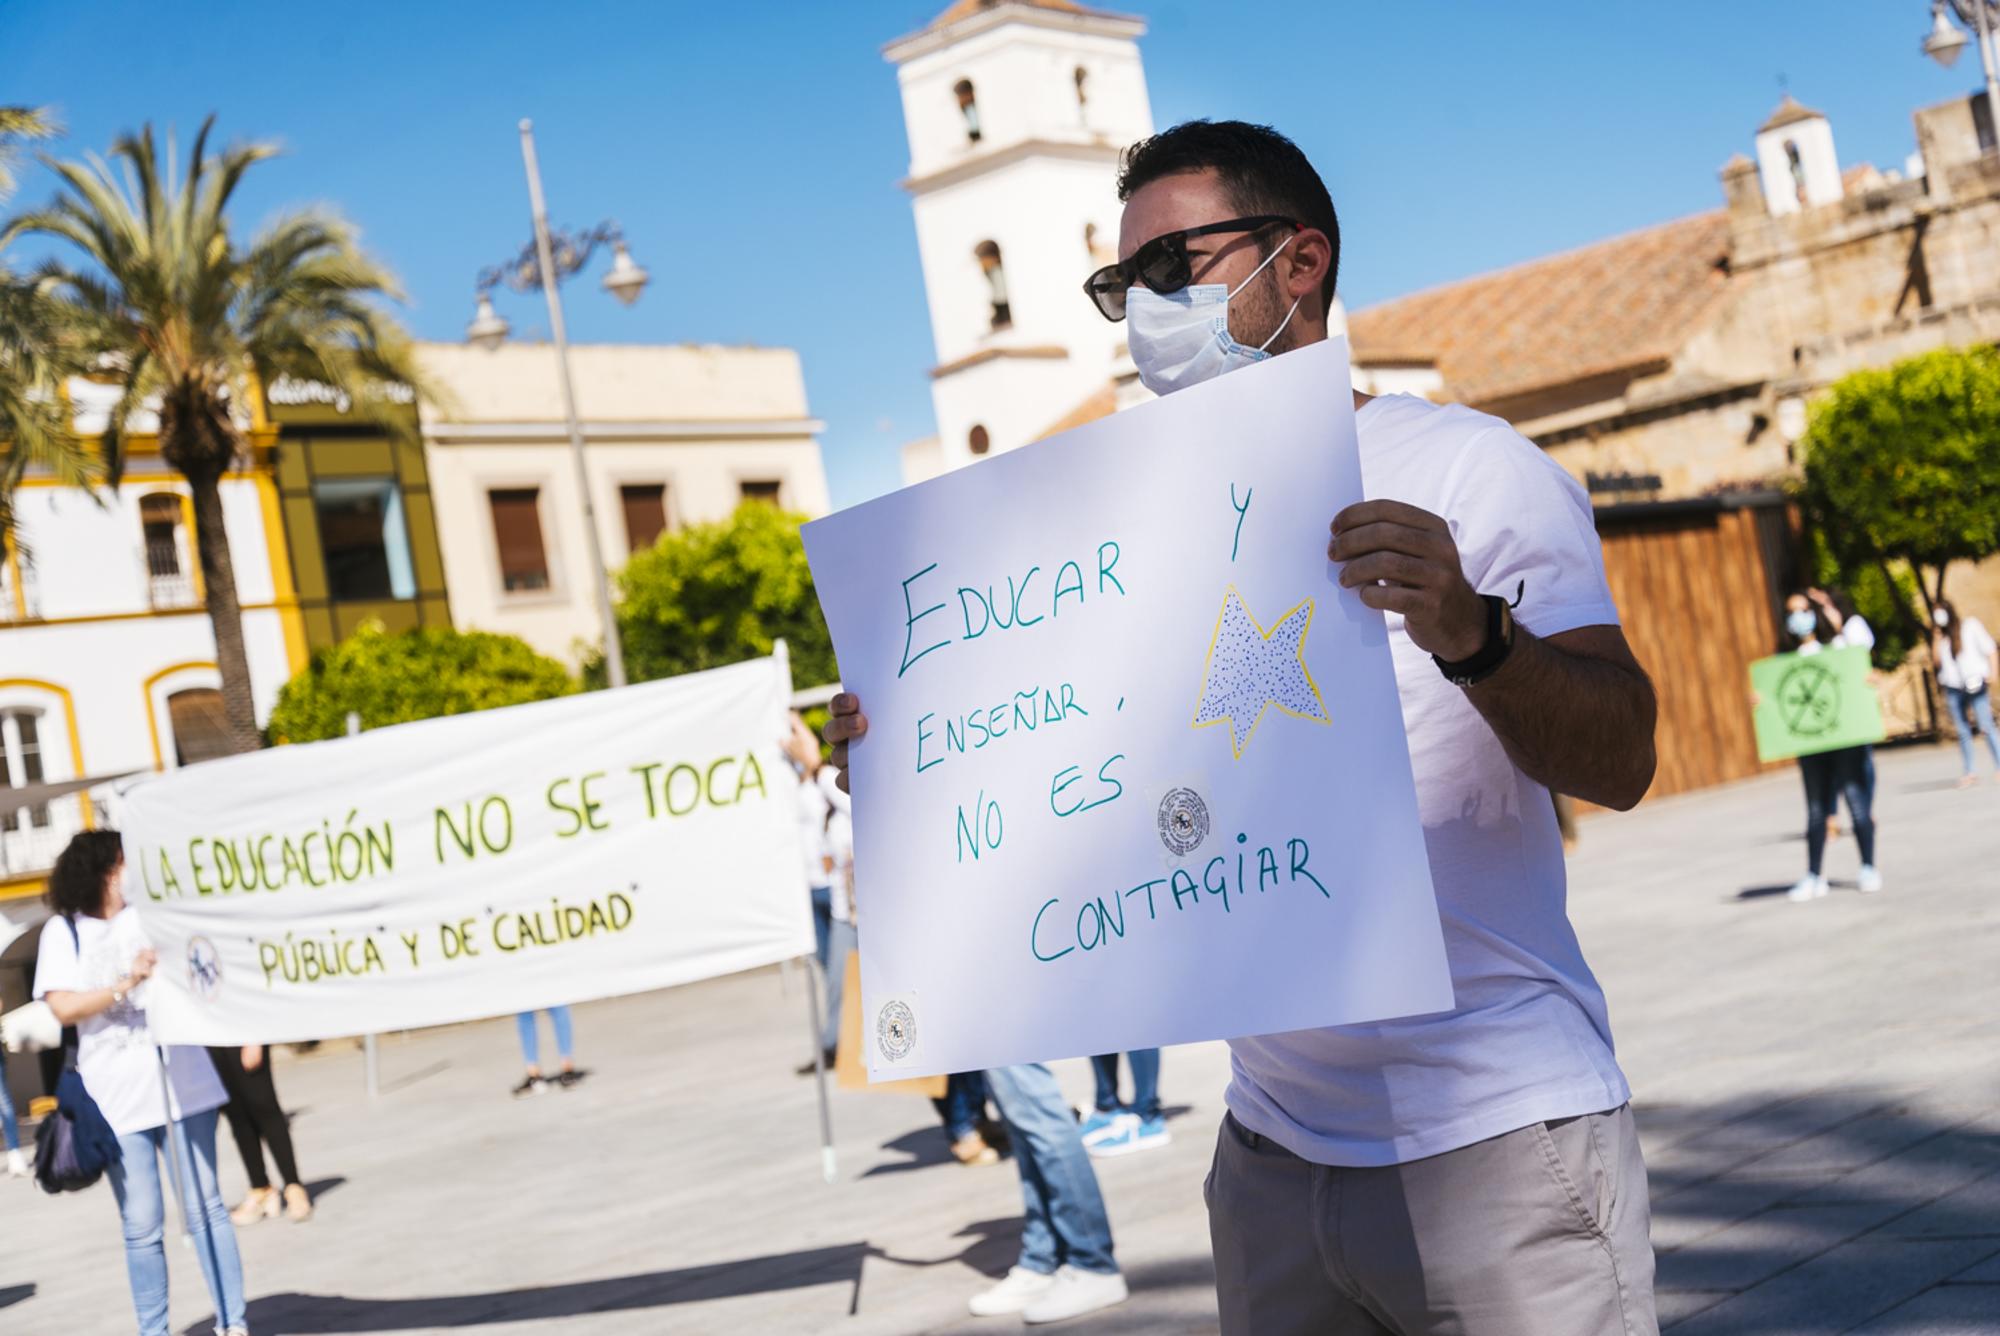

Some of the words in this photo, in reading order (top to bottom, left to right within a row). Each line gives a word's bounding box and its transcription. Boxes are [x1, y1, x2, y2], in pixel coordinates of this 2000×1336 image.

[898, 540, 1126, 679] EDUCAR
[1230, 482, 1253, 563] Y
[138, 846, 184, 901] LA
[433, 793, 514, 865] NO
[546, 771, 610, 838] SE
[629, 749, 768, 821] TOCA
[956, 790, 1004, 863] NO
[1049, 752, 1127, 818] ES
[400, 932, 419, 968] Y
[440, 917, 480, 960] DE
